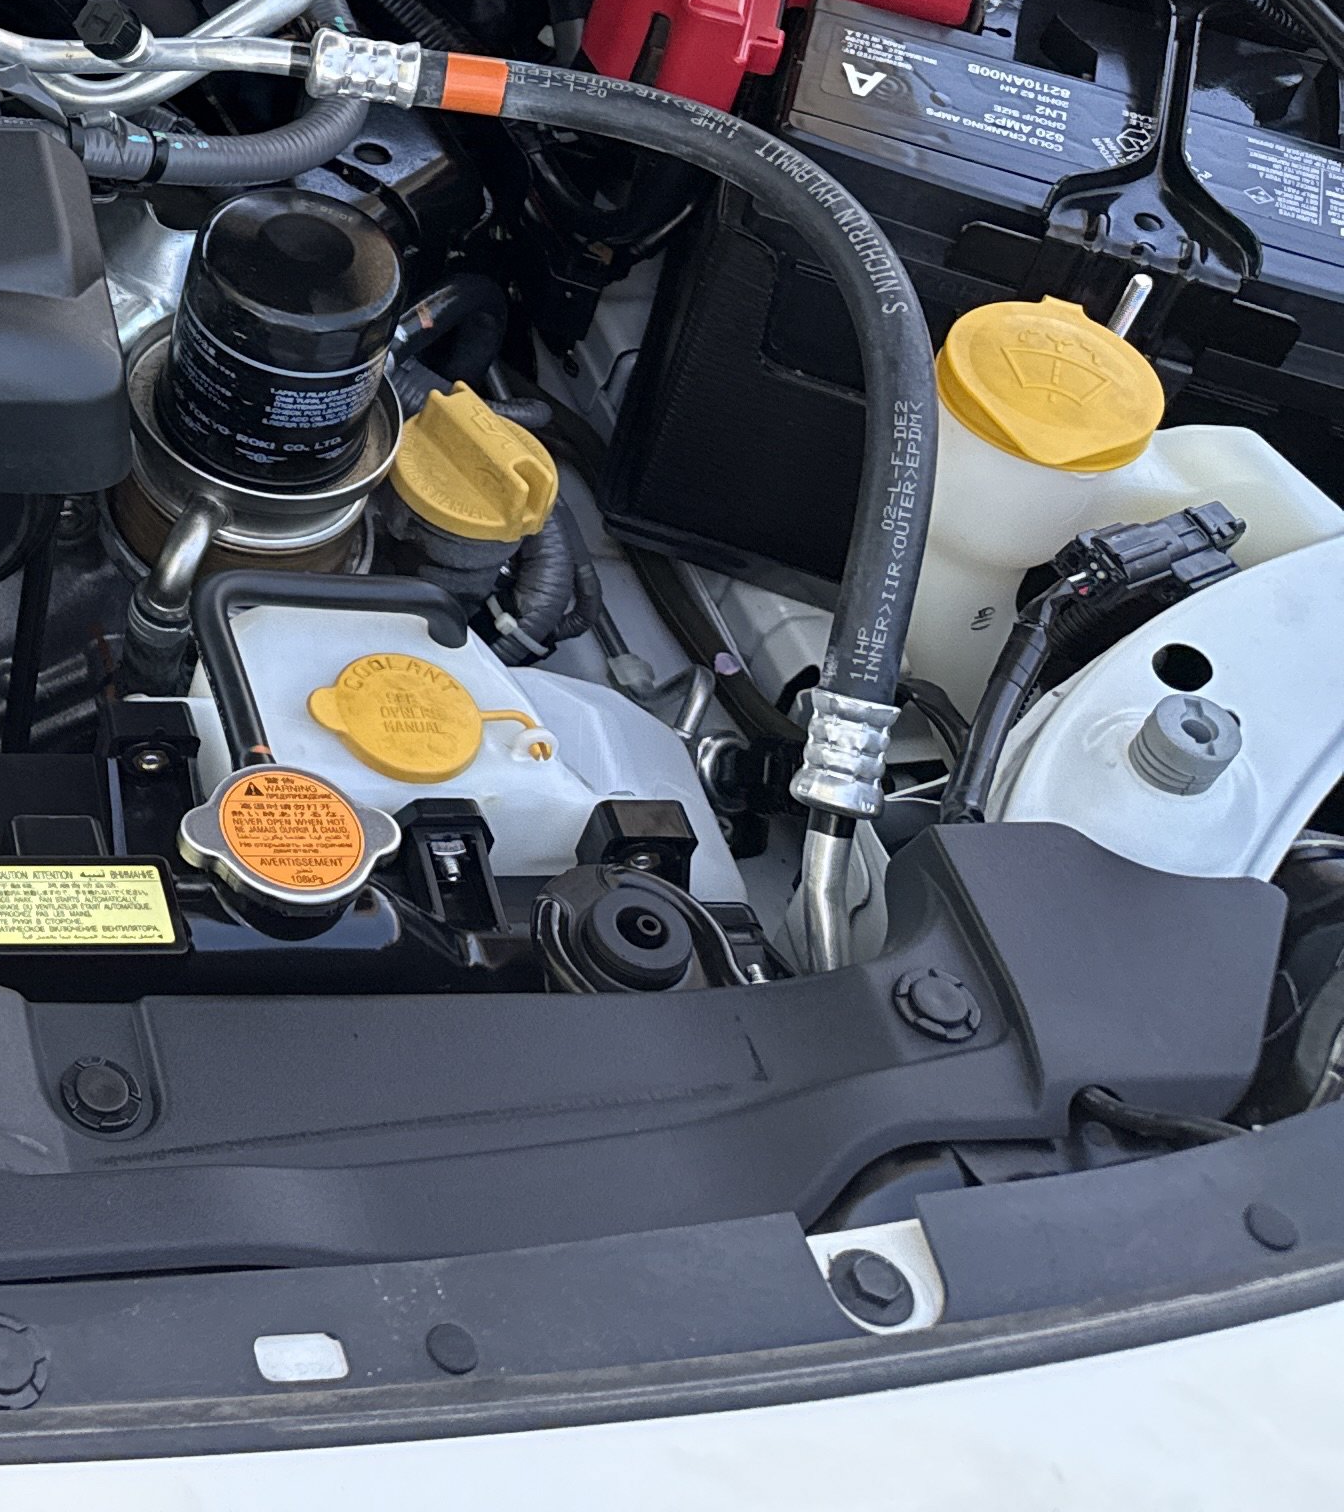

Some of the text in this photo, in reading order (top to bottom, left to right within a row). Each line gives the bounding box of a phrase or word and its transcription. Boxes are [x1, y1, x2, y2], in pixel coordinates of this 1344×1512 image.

[1035, 104, 1068, 121] LN2
[925, 107, 1064, 152] COLD CRANKING AMPS
[983, 113, 1065, 143] 620 AMPS
[1021, 114, 1067, 131] GROUP
[343, 656, 460, 691] COOLANT
[263, 784, 318, 793] WARNING
[232, 818, 263, 826] NEVER
[266, 818, 292, 826] OPEN
[295, 818, 324, 826] WHEN
[259, 857, 344, 867] AVERTISSEMENT
[32, 870, 74, 880] ATTENTION
